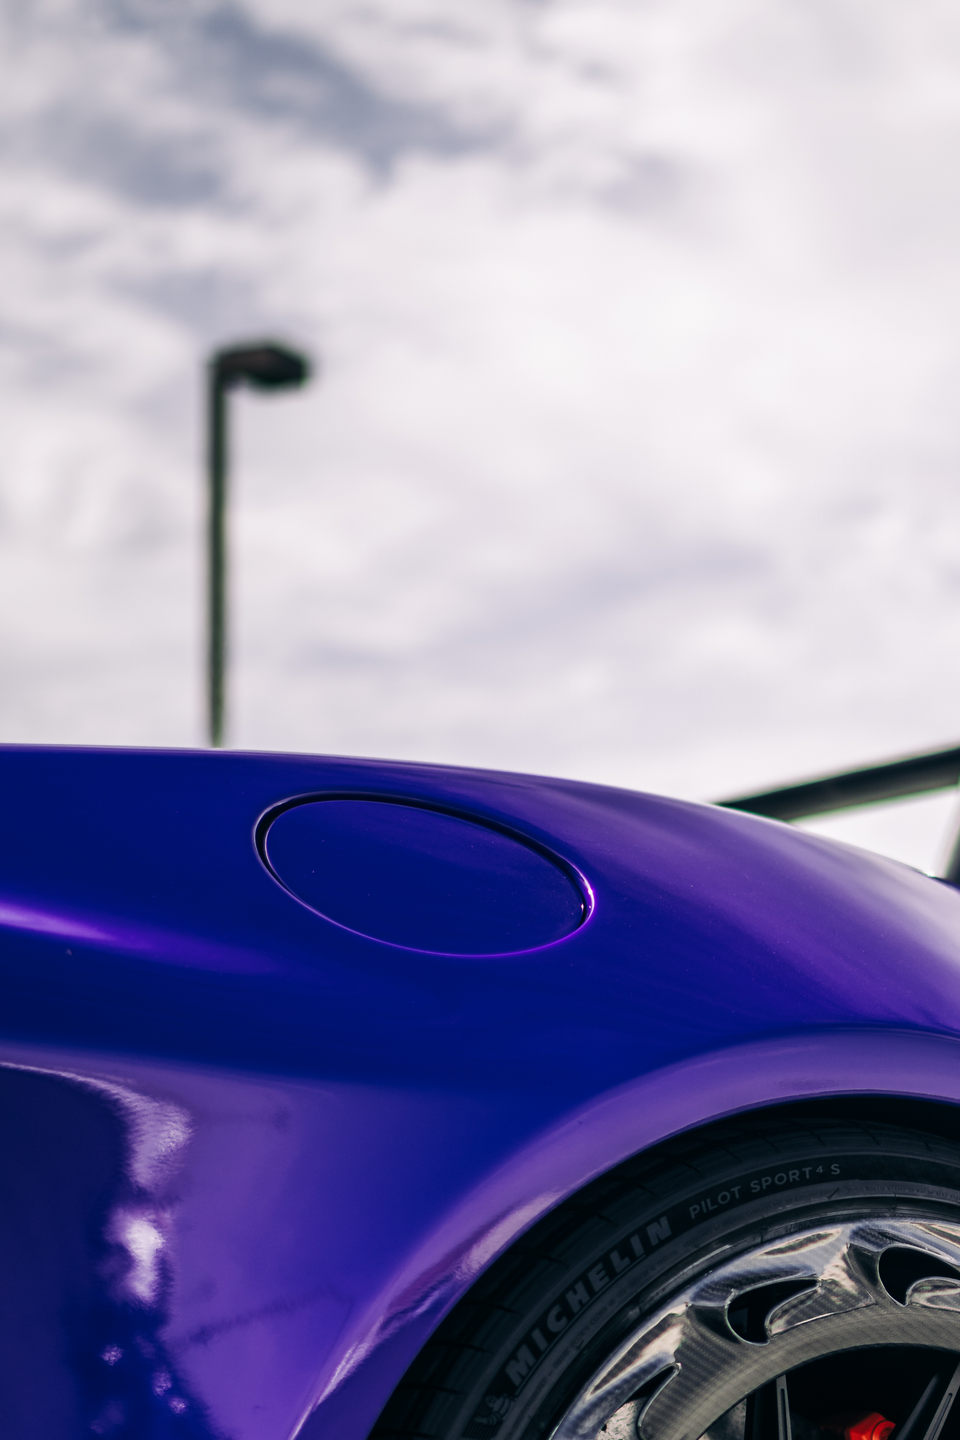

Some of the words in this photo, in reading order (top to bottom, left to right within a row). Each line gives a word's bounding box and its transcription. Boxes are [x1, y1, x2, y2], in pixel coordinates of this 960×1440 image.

[688, 1185, 742, 1220] PILOT
[830, 1163, 841, 1175] S
[504, 1215, 672, 1387] MICHELIN
